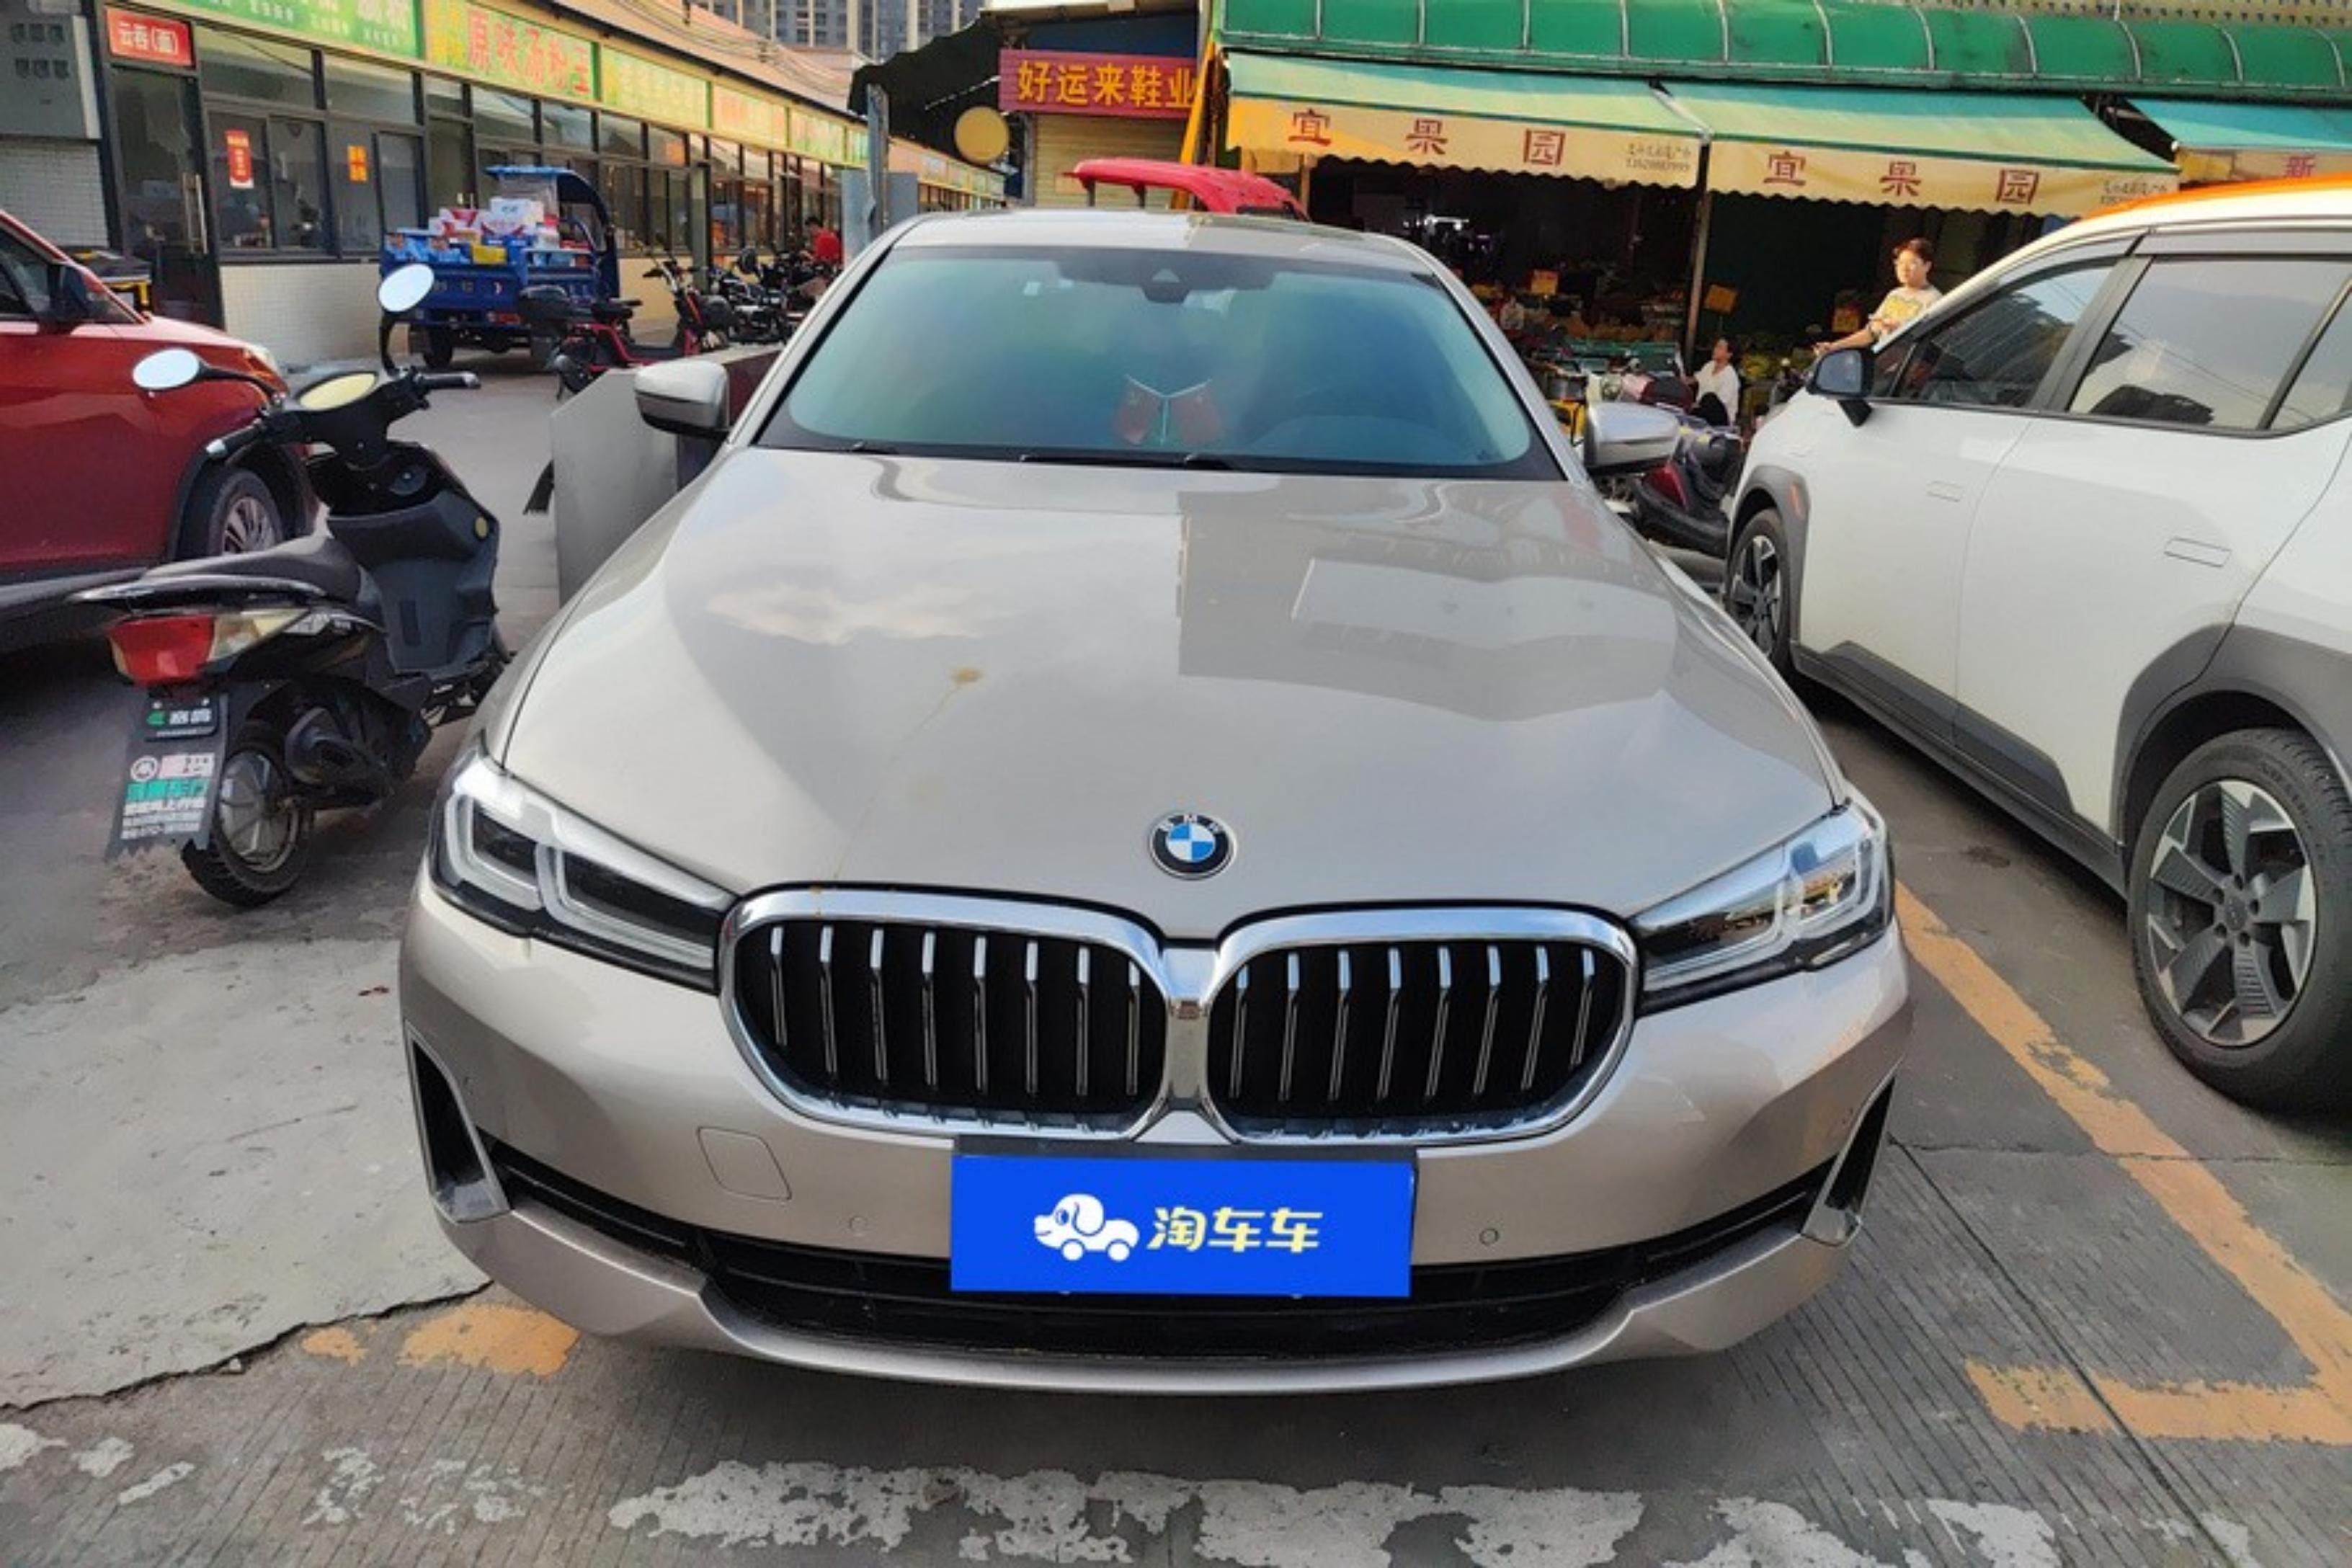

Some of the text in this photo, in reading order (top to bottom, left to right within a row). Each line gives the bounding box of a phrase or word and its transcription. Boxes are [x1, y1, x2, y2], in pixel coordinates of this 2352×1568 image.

[1018, 60, 1196, 108] 好运来鞋业
[1288, 108, 1566, 166] 宜果园
[1763, 151, 2039, 205] 宜果园
